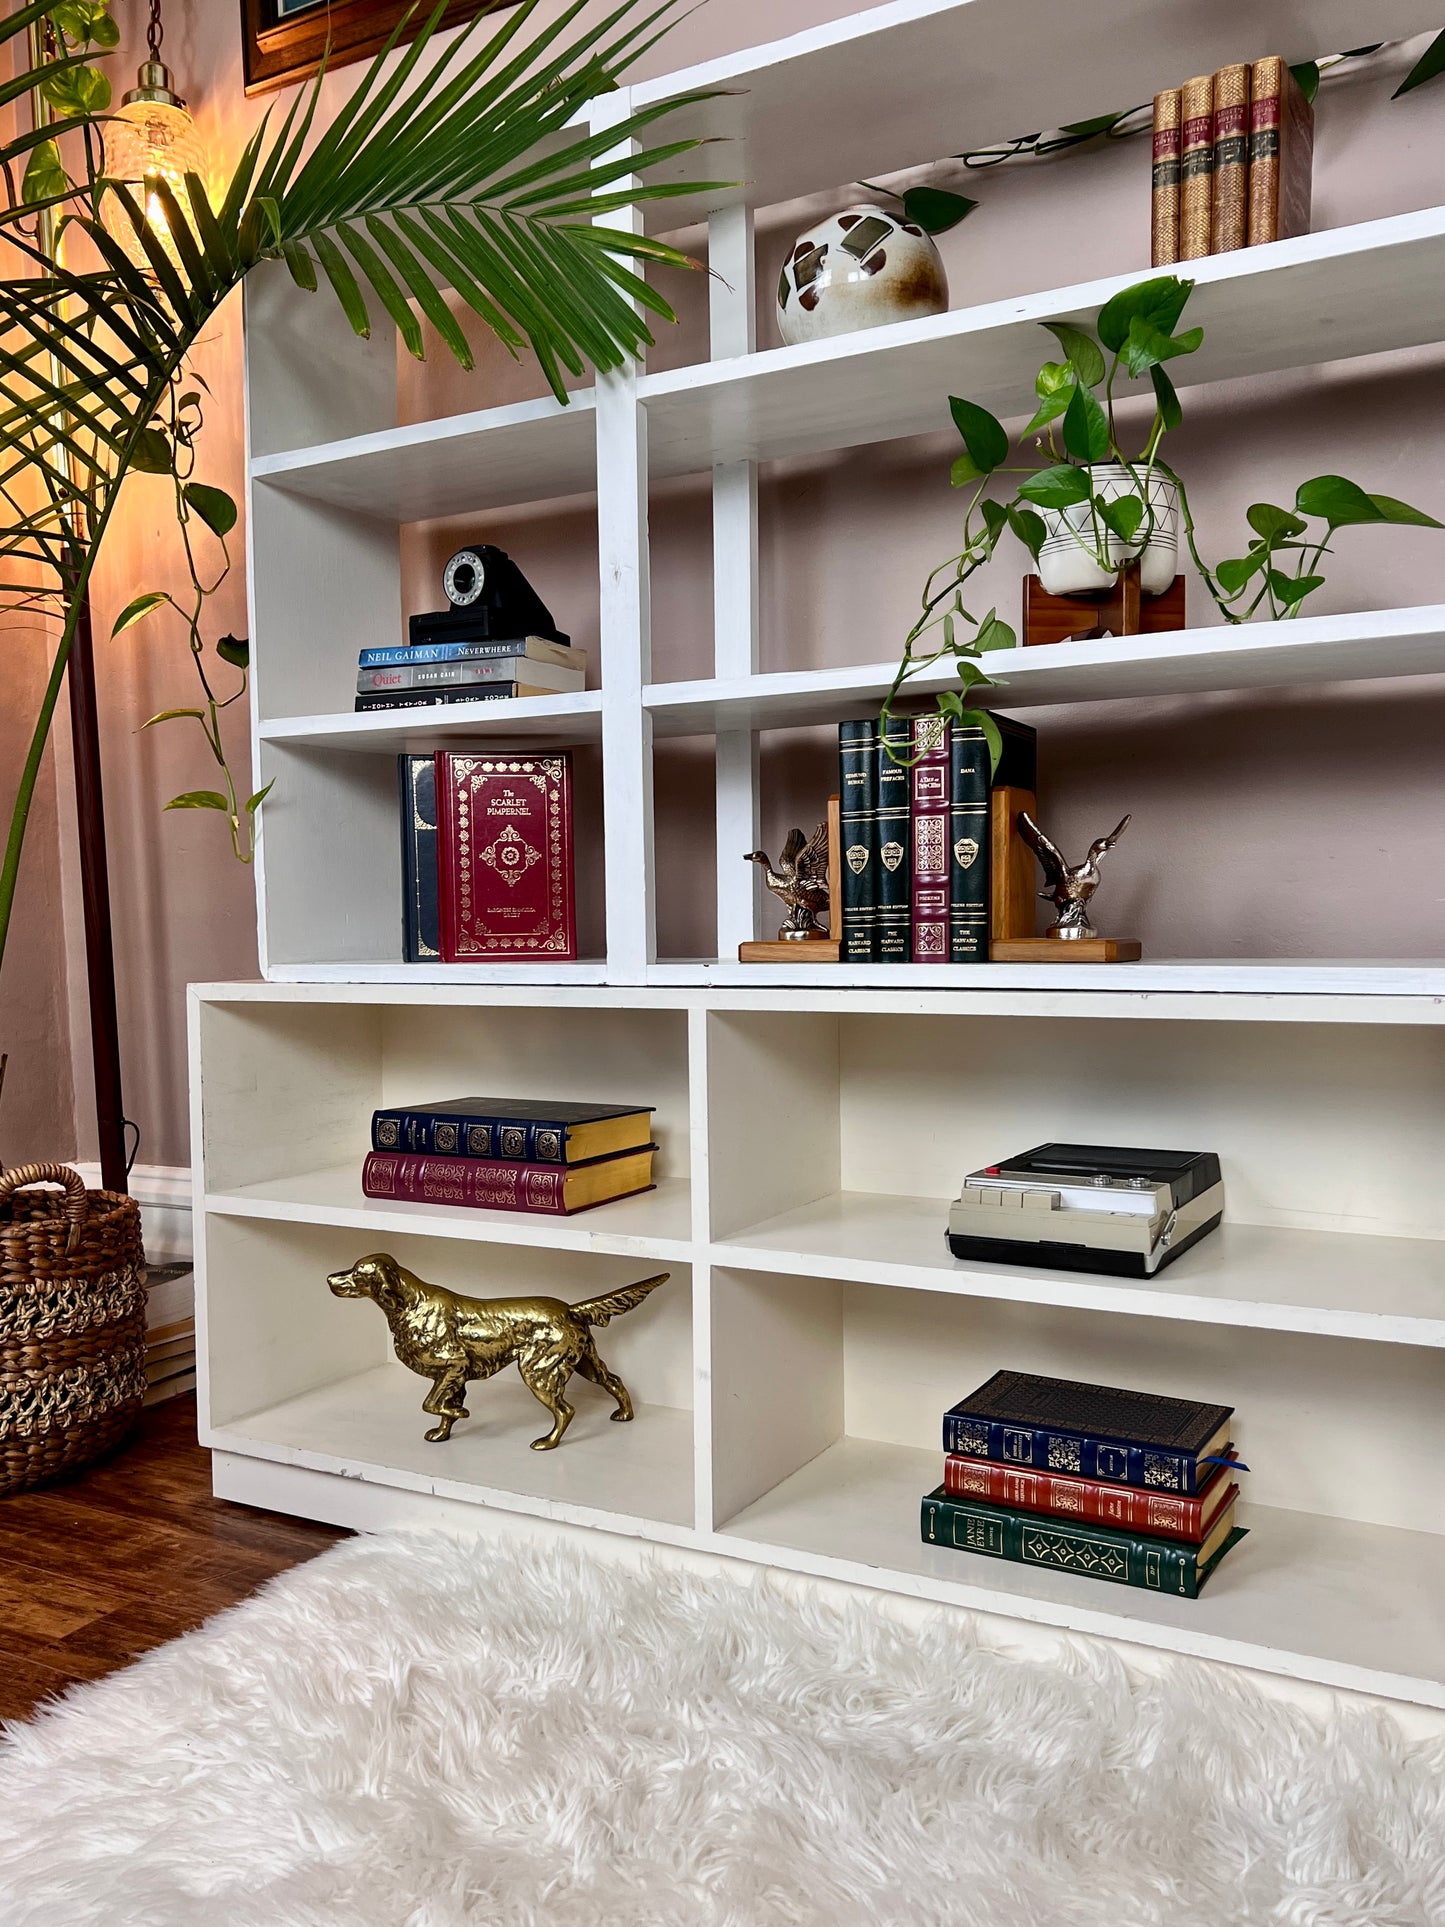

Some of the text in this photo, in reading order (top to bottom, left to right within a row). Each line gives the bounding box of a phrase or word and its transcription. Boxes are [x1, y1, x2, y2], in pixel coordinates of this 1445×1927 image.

[367, 653, 392, 662] NEIL
[395, 648, 439, 661] GAIMAN
[457, 645, 512, 656] NEVERWHERE
[371, 672, 402, 688] Quiet
[502, 789, 515, 797] The
[490, 798, 527, 807] SCARLET
[486, 807, 532, 816] PIMPERNEL
[966, 1518, 976, 1547] JANE
[976, 1519, 985, 1547] EYRE
